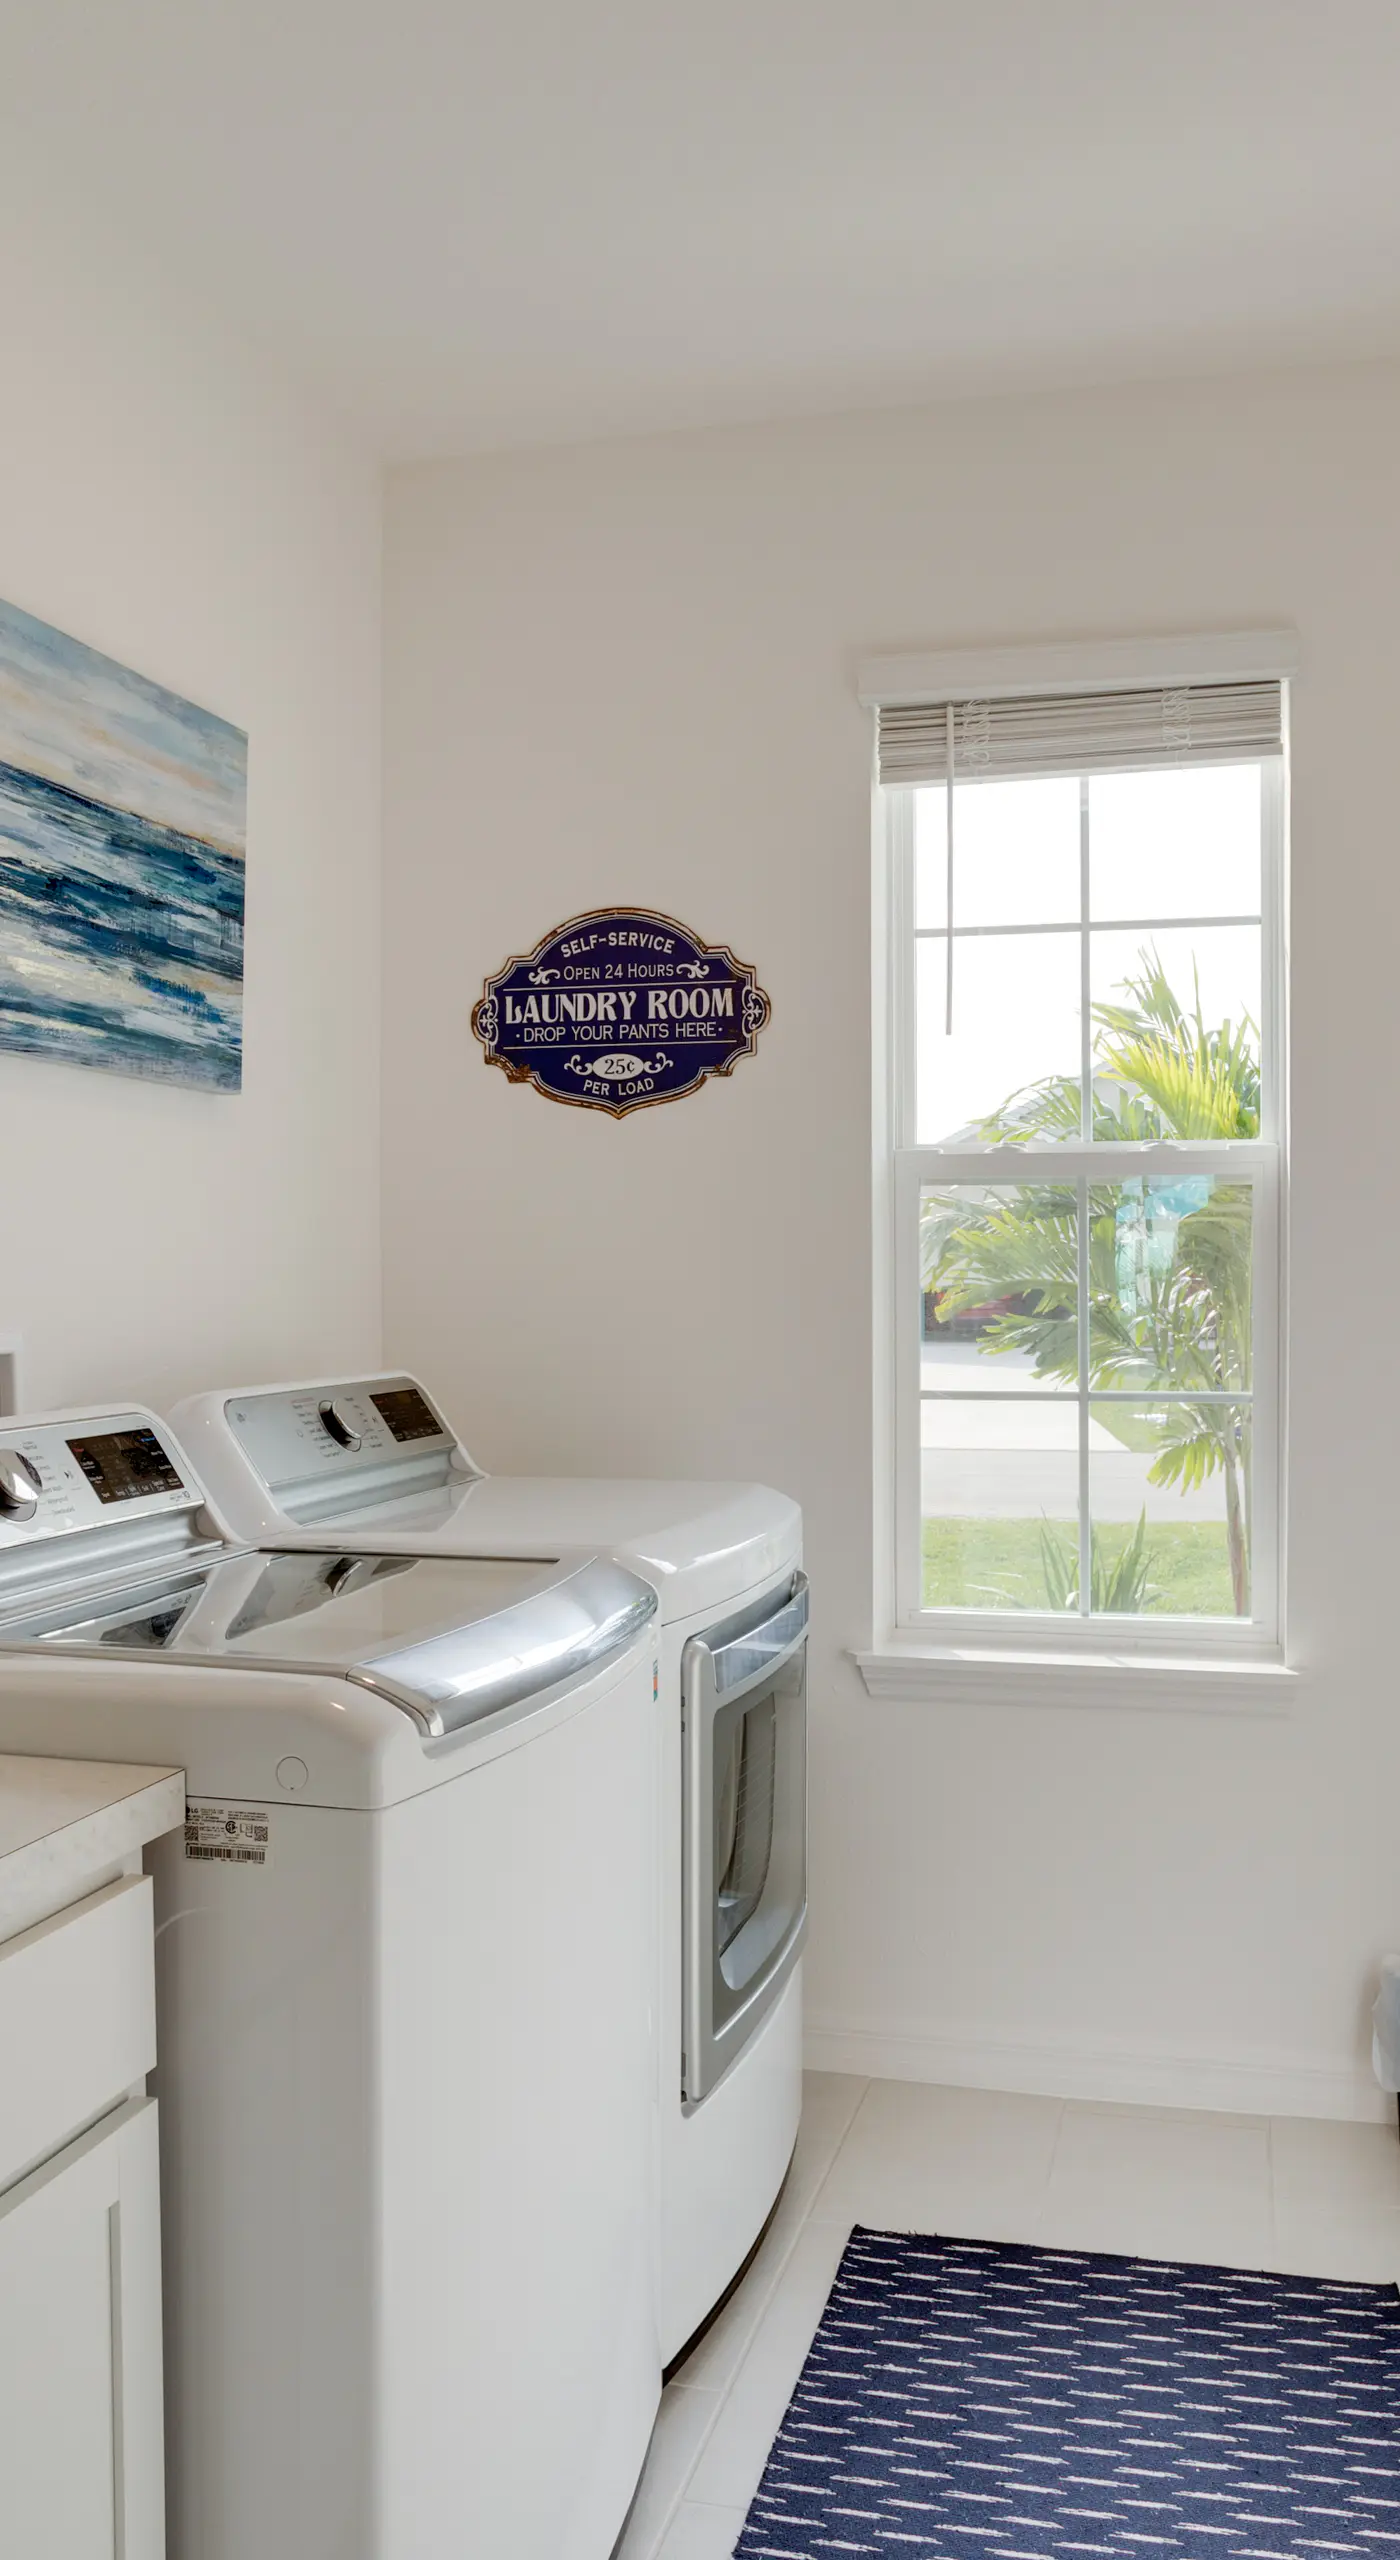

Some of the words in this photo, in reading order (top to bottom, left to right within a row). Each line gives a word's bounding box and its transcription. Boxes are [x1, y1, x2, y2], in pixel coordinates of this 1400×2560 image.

[561, 932, 675, 958] SELF-SERVICE
[564, 966, 600, 980] OPEN
[605, 964, 623, 978] 24
[628, 963, 674, 978] HOURS
[505, 990, 637, 1024] LAUNDRY
[648, 988, 734, 1020] ROOM
[573, 1025, 613, 1040] YOUR
[619, 1024, 669, 1039] PANTS
[583, 1080, 609, 1095] PER
[618, 1077, 654, 1095] LOAD
